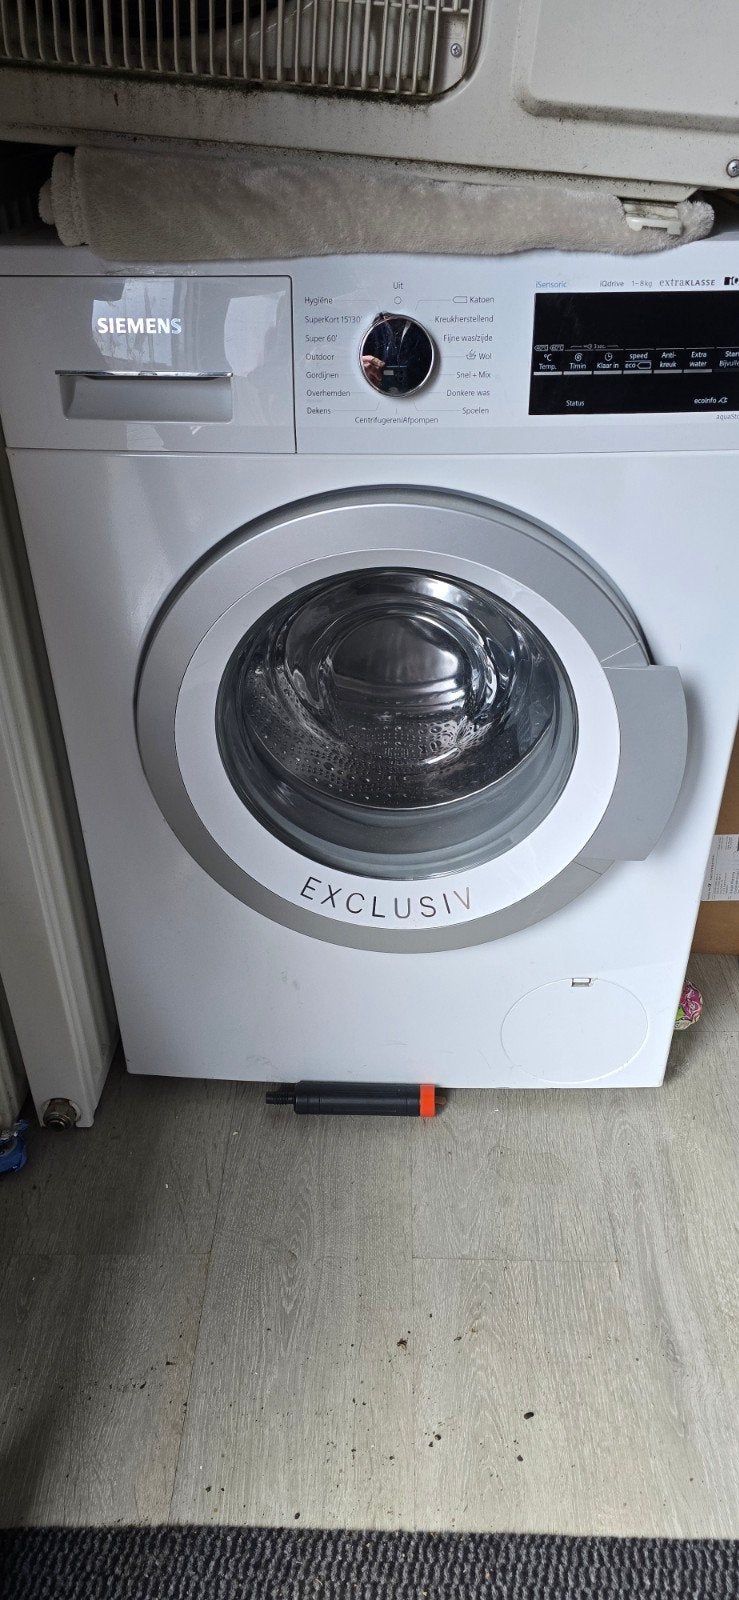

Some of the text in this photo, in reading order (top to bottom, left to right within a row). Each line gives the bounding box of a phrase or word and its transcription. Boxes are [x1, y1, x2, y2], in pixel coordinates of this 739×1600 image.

[392, 281, 404, 290] Uit
[535, 280, 567, 289] iSensoric
[599, 280, 625, 288] iQdrive
[659, 277, 716, 287] extraKLASSE
[469, 296, 495, 304] Katoen
[304, 315, 340, 325] SuperKort
[434, 315, 494, 323] Kreukherstellend
[97, 317, 182, 334] SIEMENS
[305, 334, 338, 344] Super 60'
[443, 334, 460, 343] Fijne
[305, 353, 335, 361] Outdoor
[478, 352, 492, 360] Wol
[629, 351, 649, 361] speed
[661, 350, 677, 359] Anti-
[691, 350, 707, 358] Extra
[539, 362, 557, 371] Temp.
[596, 361, 620, 369] Klaar in
[659, 360, 677, 368] kreuk
[689, 360, 707, 368] water
[305, 371, 339, 381] Gordijnen
[456, 371, 471, 379] Snel
[306, 389, 351, 397] Overhemden
[446, 389, 475, 397] Donkere
[694, 397, 717, 405] ecoinfo
[306, 406, 332, 415] Dekens
[462, 406, 490, 416] Spoelen
[300, 876, 472, 919] EXCLUSIV
